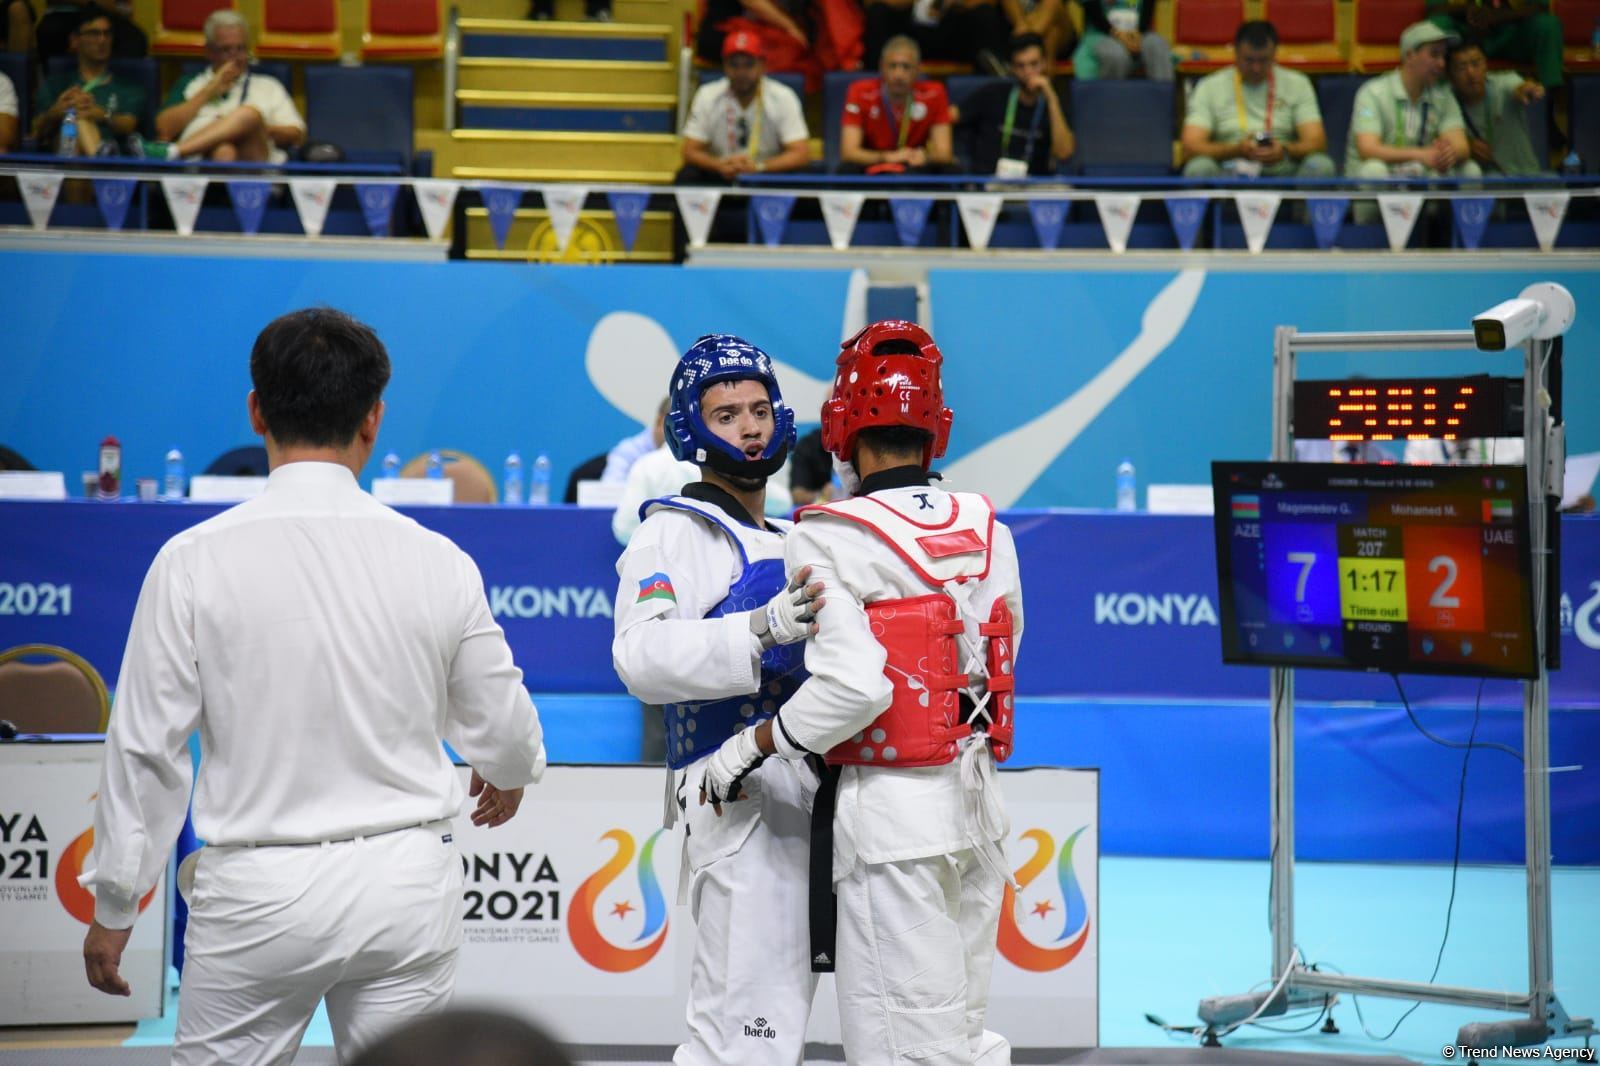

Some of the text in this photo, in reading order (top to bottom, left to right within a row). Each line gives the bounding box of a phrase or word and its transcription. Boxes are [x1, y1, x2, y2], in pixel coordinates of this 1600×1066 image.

[1391, 504, 1442, 516] Mohamed
[1234, 524, 1261, 538] AZE
[1352, 527, 1387, 538] MATCH
[1483, 529, 1514, 544] UAE
[1357, 541, 1383, 557] 207
[1286, 551, 1317, 603] 7
[1347, 568, 1398, 593] 1:17
[1427, 554, 1460, 609] 2
[0, 583, 72, 616] 2021
[491, 587, 612, 619] KONYA
[1094, 593, 1219, 626] KONYA
[1349, 604, 1399, 617] Time out
[1358, 622, 1392, 633] ROUND
[1371, 635, 1380, 649] 2
[0, 849, 48, 880] 21
[462, 852, 559, 883] NYA
[462, 889, 560, 921] 2021
[527, 935, 560, 943] GAMES
